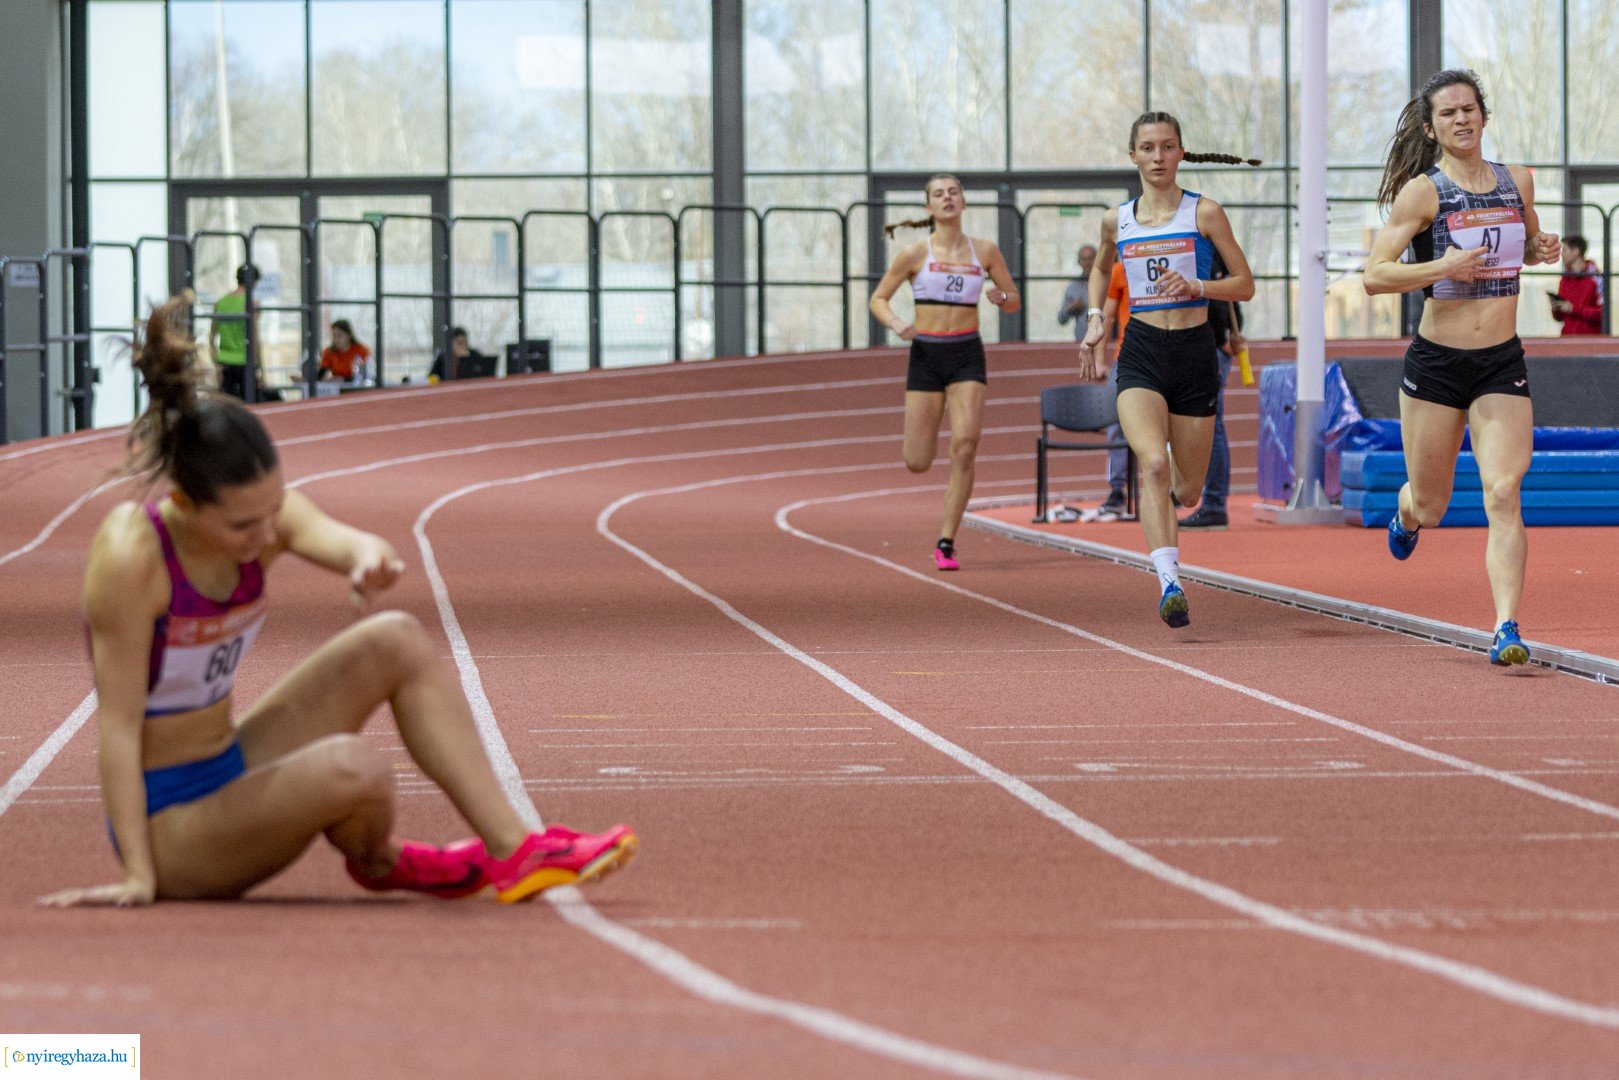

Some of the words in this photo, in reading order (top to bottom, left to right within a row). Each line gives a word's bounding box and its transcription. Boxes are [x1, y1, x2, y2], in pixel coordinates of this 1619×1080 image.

[1480, 227, 1501, 254] 47
[946, 275, 964, 293] 29
[204, 635, 244, 684] 60
